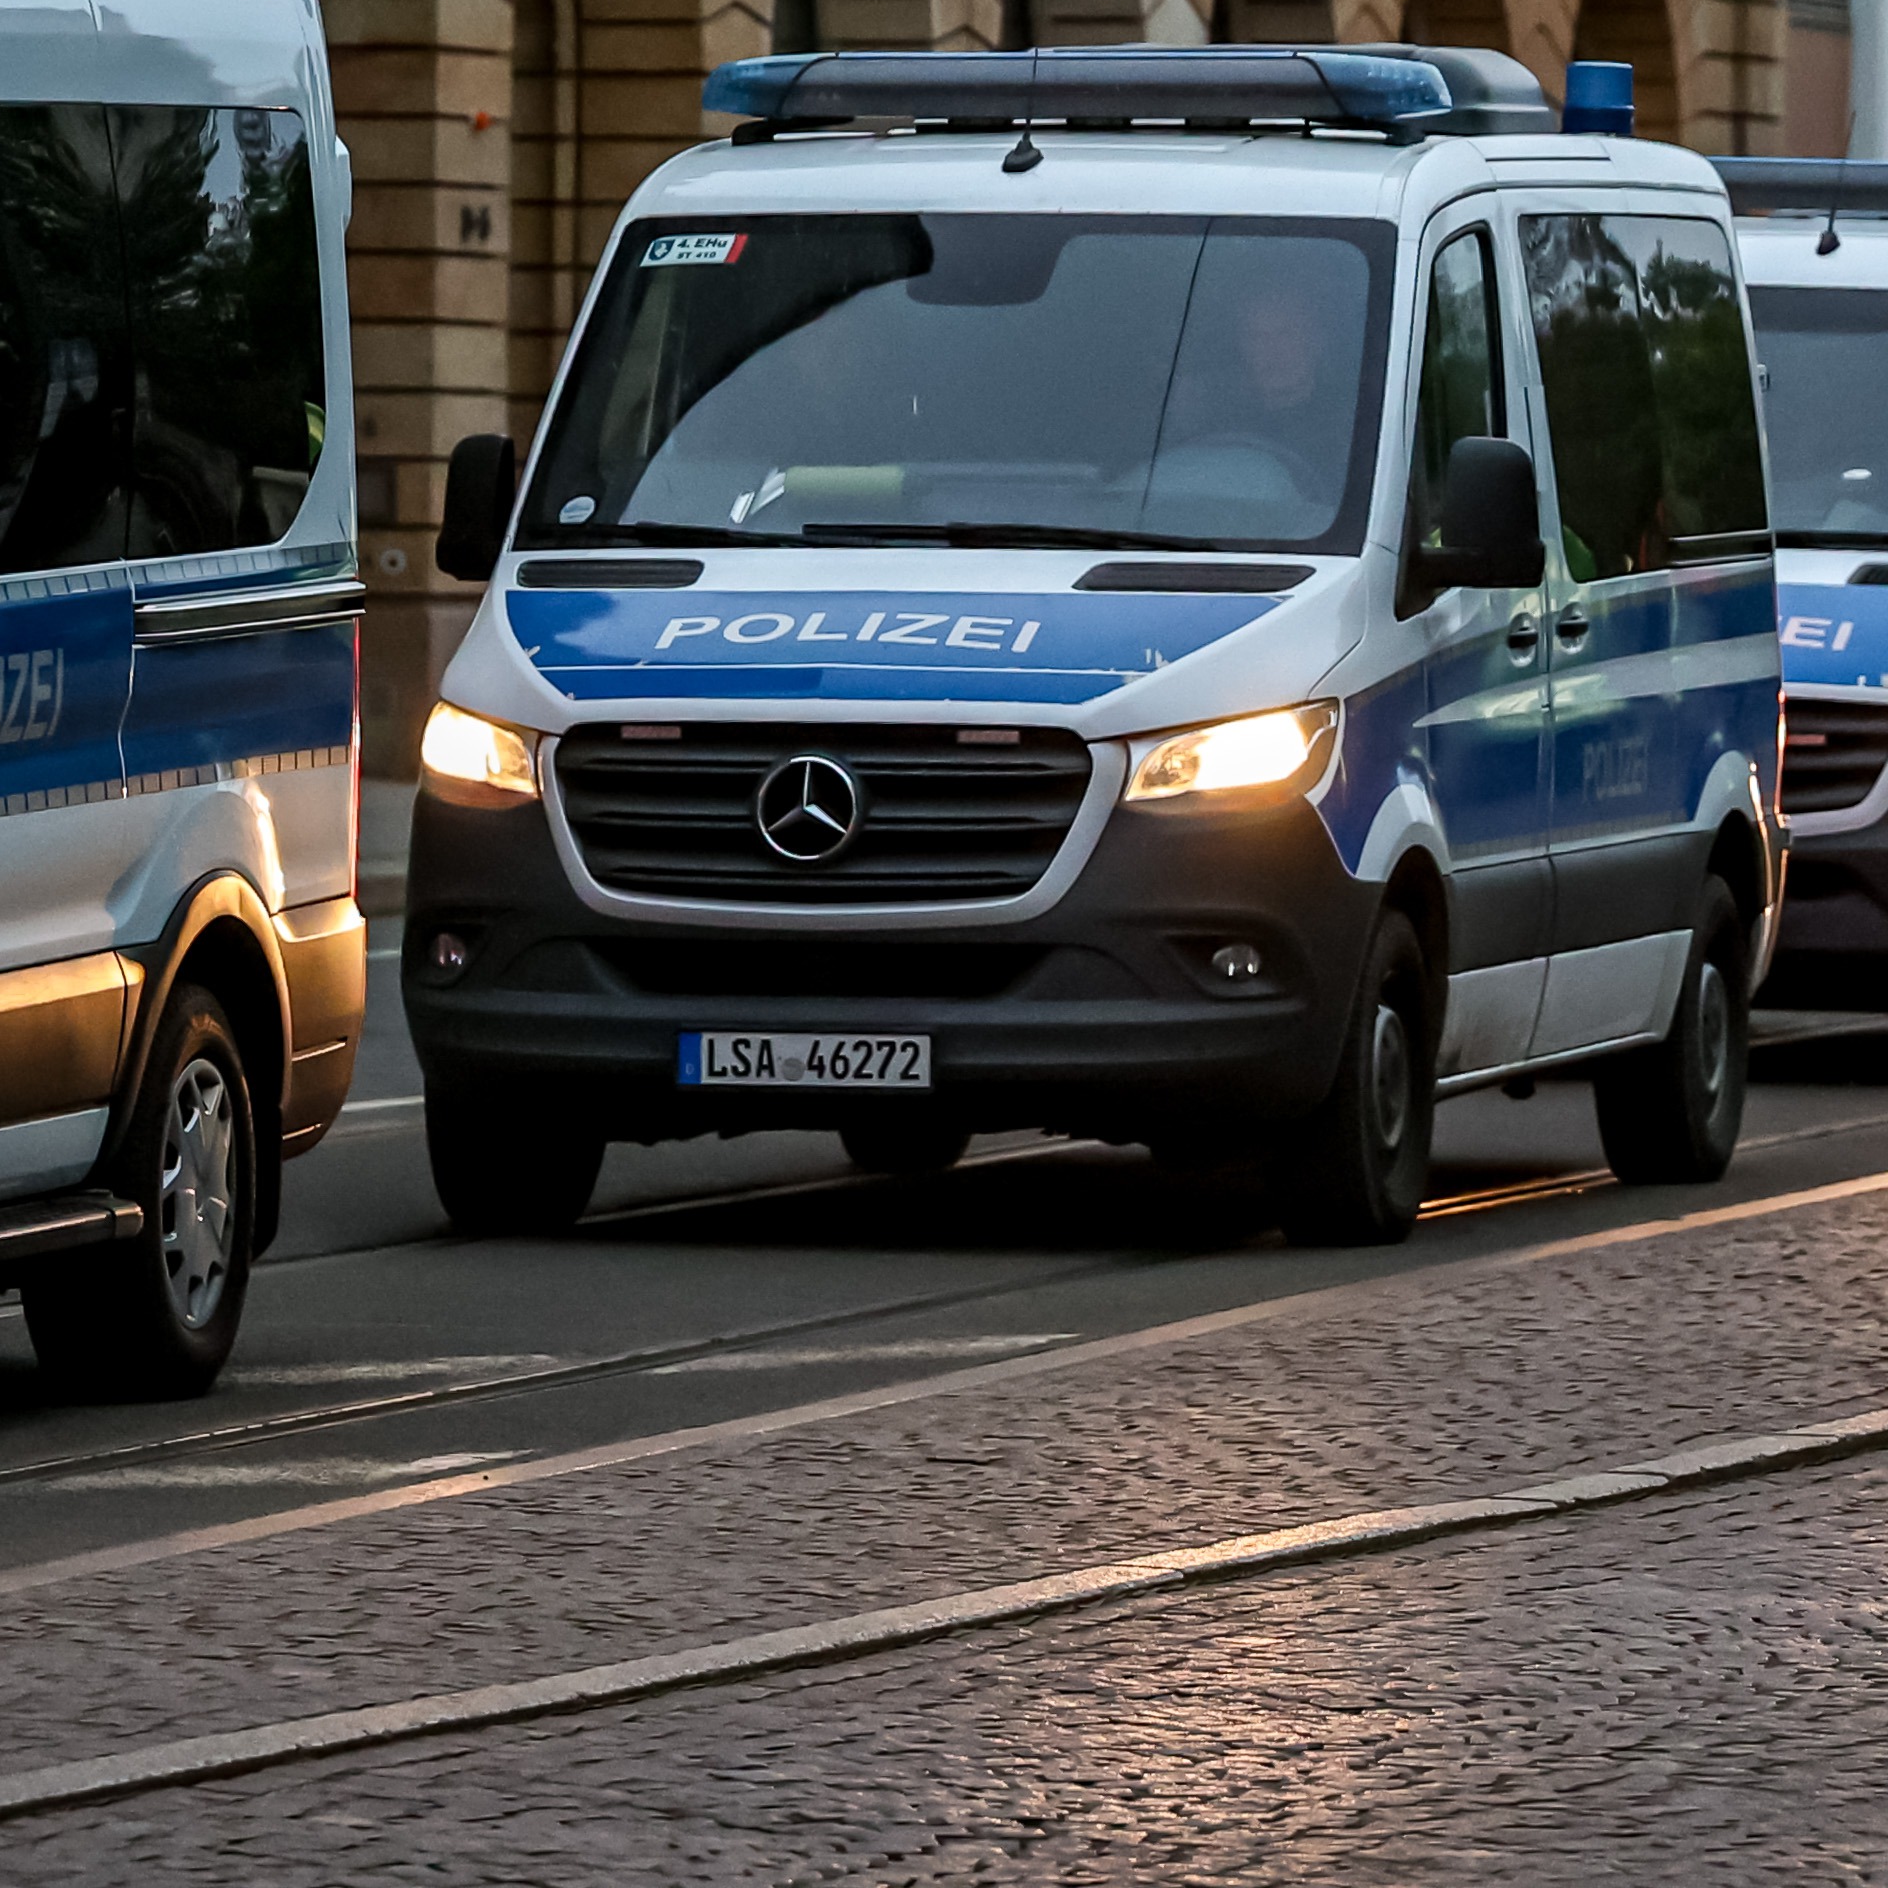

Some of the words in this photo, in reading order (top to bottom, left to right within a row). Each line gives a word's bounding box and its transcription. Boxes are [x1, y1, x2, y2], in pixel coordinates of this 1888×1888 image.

[677, 239, 689, 248] 4.
[694, 238, 728, 248] EHu
[654, 611, 1041, 654] POLIZEI
[707, 1038, 776, 1079] LSA
[806, 1040, 921, 1081] 46272
